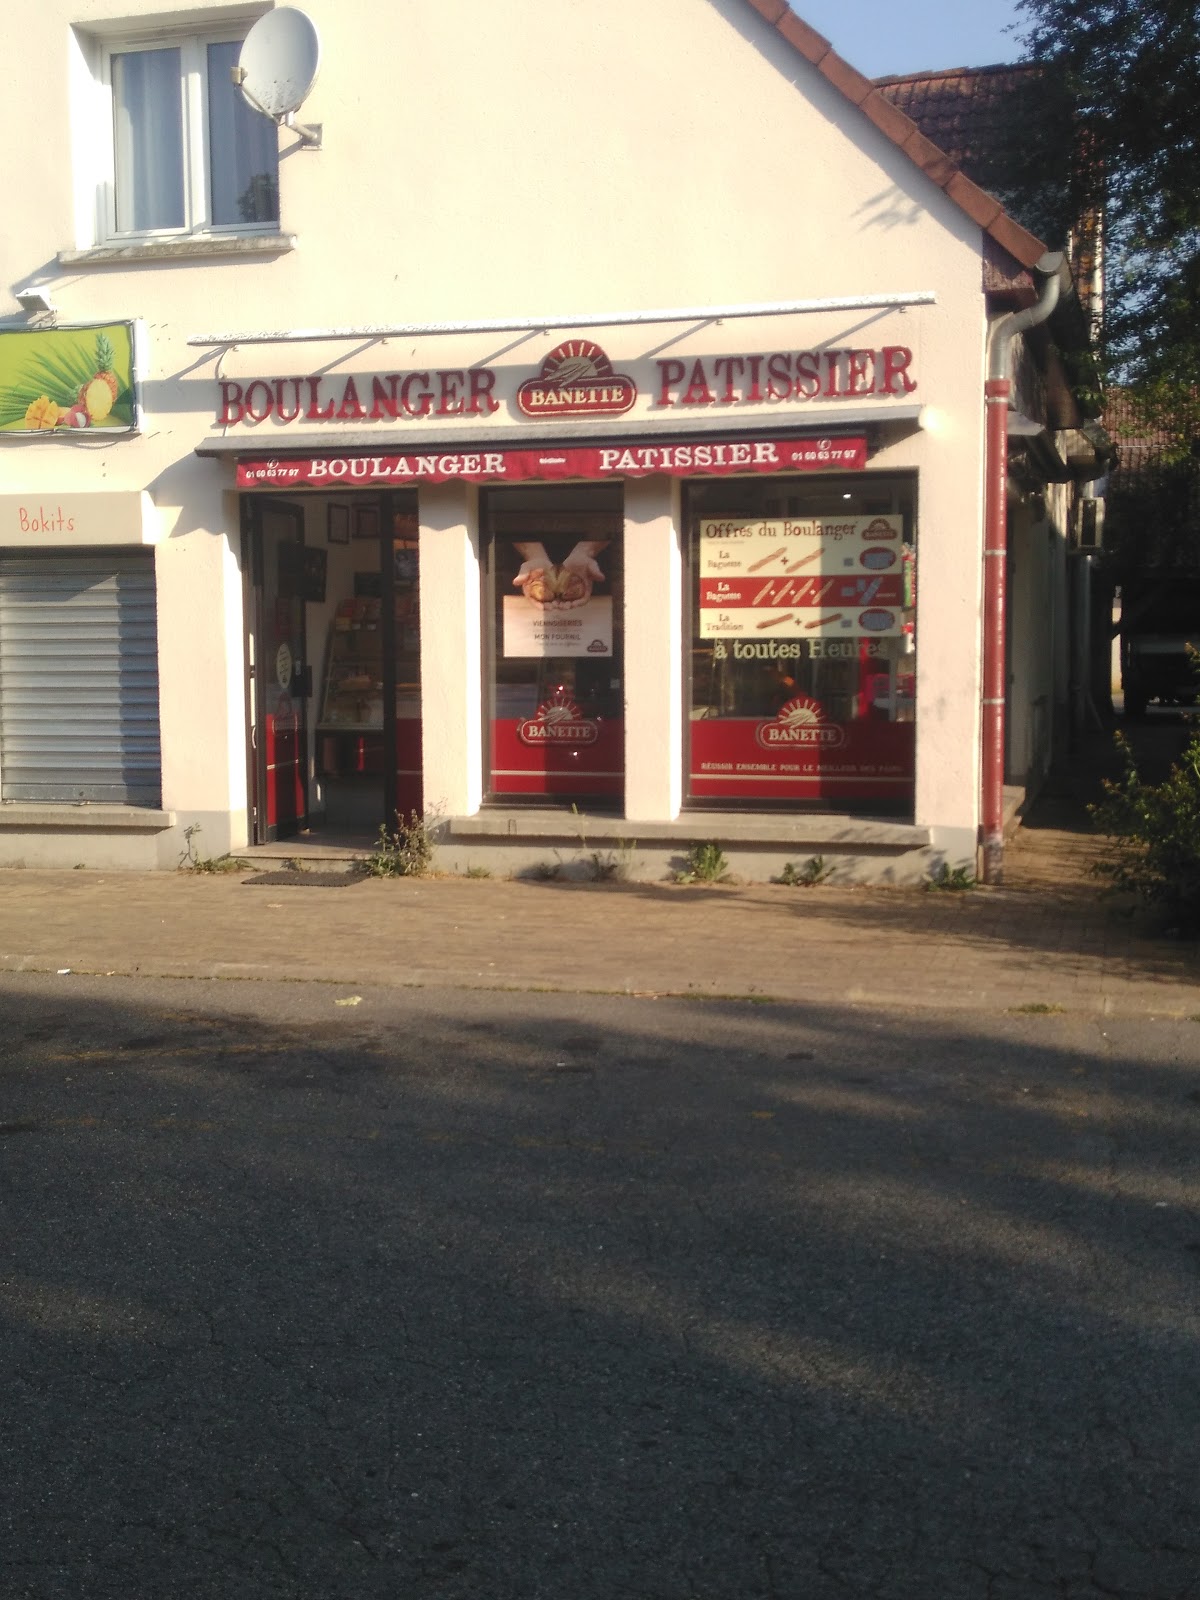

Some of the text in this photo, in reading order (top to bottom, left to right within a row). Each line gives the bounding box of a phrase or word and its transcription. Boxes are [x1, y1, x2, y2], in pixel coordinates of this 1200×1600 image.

[656, 345, 918, 406] PATISSIER
[218, 368, 500, 425] BOULANGER
[529, 385, 624, 406] BANETTE
[599, 442, 780, 470] PATISSIER
[791, 451, 803, 461] 01
[831, 449, 843, 459] 77
[843, 449, 857, 459] 97
[308, 453, 506, 478] BOULANGER
[246, 470, 255, 479] 01
[277, 468, 288, 477] 77
[288, 468, 300, 477] 97
[19, 506, 75, 533] Bokits
[706, 520, 857, 541] Offres du Boulanger
[719, 550, 730, 559] La
[717, 582, 730, 591] La
[719, 613, 730, 622] La
[706, 621, 744, 631] Tradition
[715, 638, 889, 660] à toutes Heures
[528, 725, 591, 738] BANETTE
[768, 728, 837, 742] BANETTE
[736, 762, 777, 771] ENSEMBLE
[780, 763, 801, 772] POUR
[802, 764, 814, 772] LE
